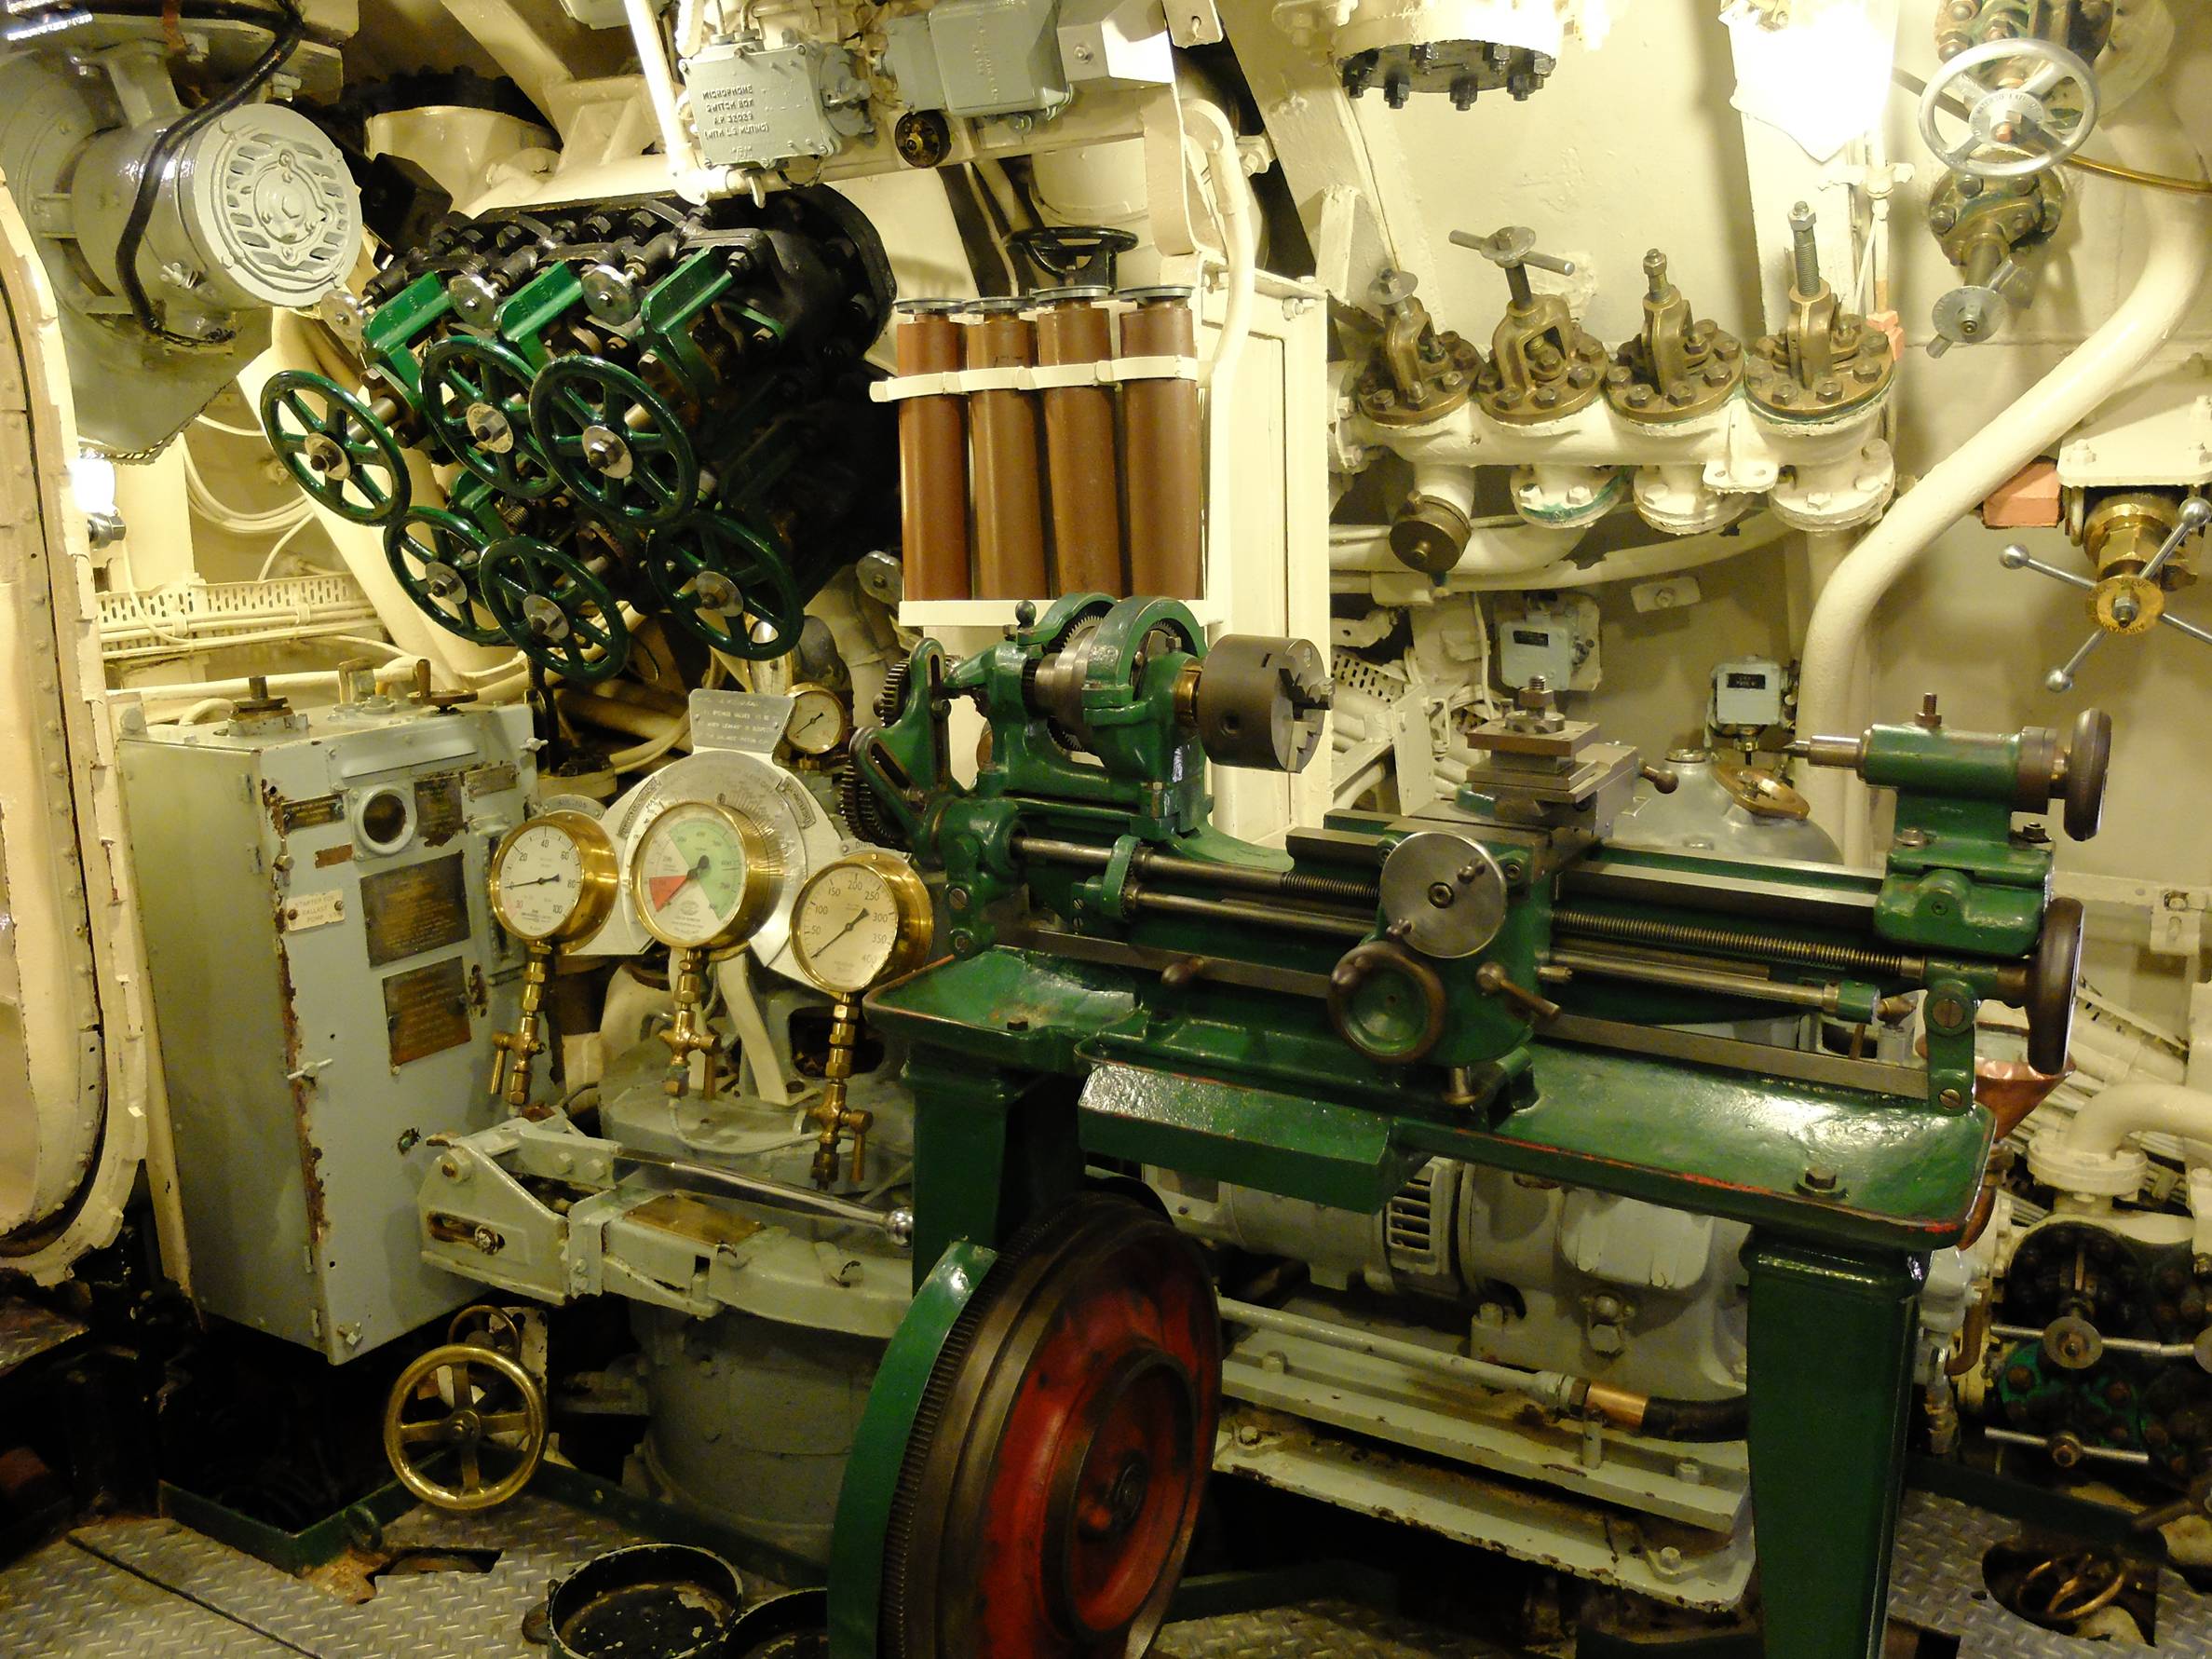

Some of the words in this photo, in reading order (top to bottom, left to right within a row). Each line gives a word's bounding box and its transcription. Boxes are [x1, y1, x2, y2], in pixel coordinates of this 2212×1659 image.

[702, 84, 753, 100] MICROPHONE
[706, 100, 737, 113] SWITCH
[738, 98, 754, 110] BOX
[540, 839, 550, 849] 40
[519, 852, 527, 862] 20
[561, 851, 570, 861] 60
[567, 879, 577, 889] 80
[848, 880, 863, 891] 200
[828, 886, 841, 896] 150
[864, 891, 880, 902] 250
[552, 904, 563, 915] 100
[815, 904, 828, 915] 100
[873, 912, 889, 922] 300
[811, 927, 821, 935] 50
[872, 934, 887, 944] 350
